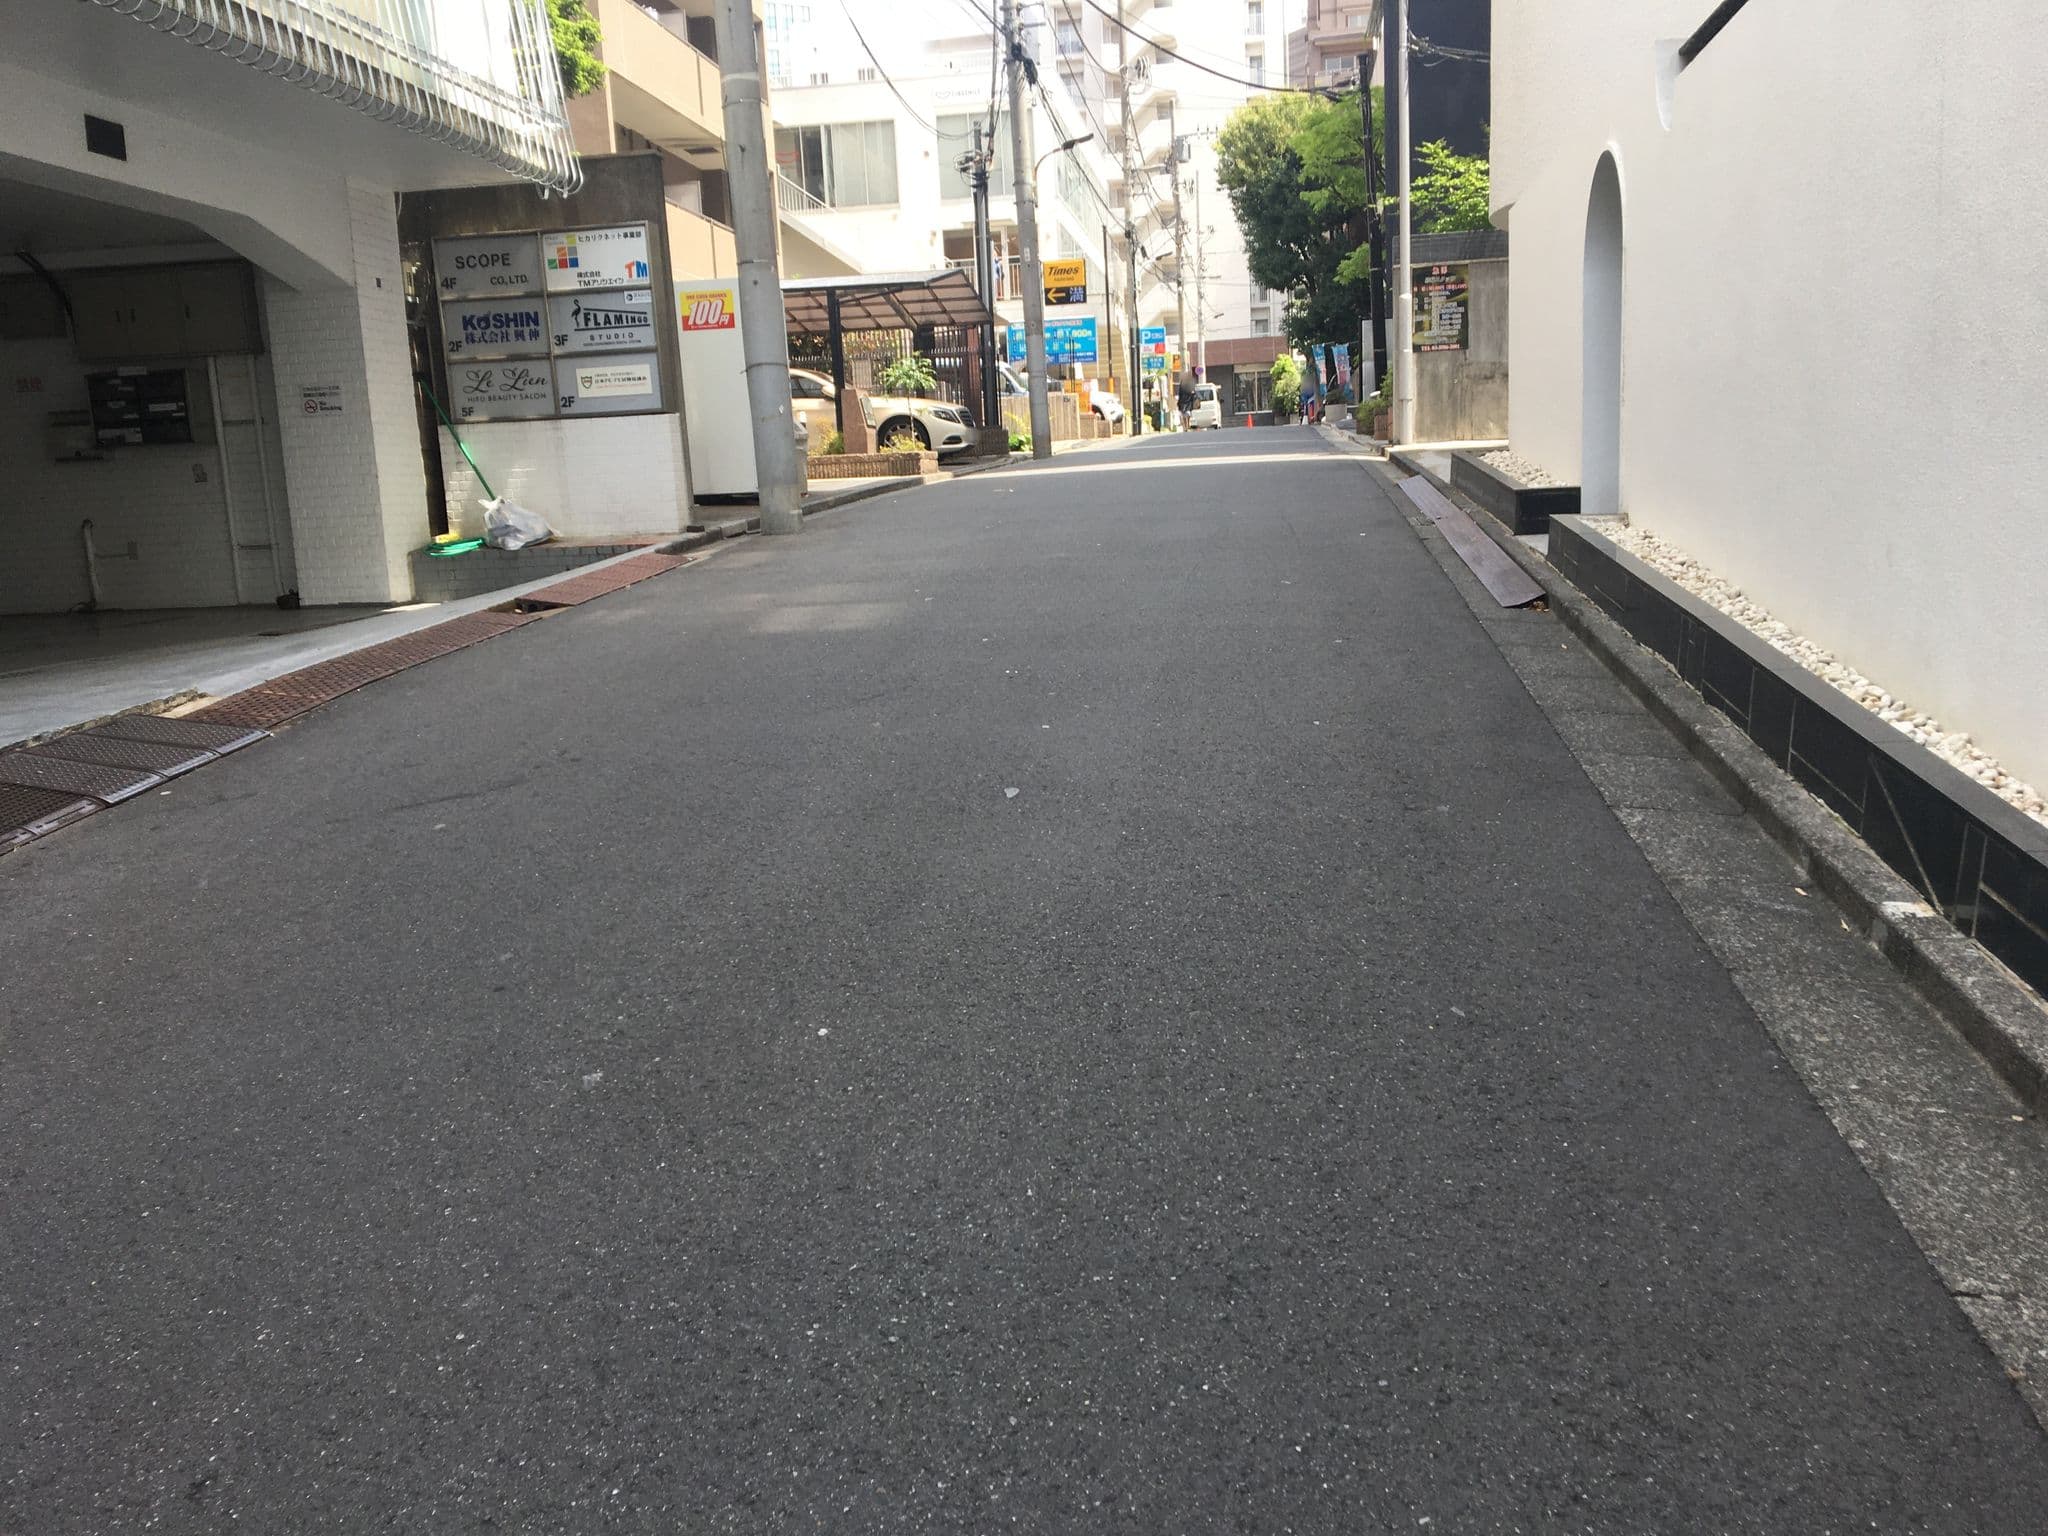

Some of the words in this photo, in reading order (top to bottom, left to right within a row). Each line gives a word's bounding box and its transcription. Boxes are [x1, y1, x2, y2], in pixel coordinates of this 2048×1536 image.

[455, 253, 512, 269] SCOPE
[625, 260, 648, 279] TM
[1048, 266, 1080, 276] Times
[441, 277, 457, 289] 4F
[583, 312, 648, 327] FLAMINGO
[554, 334, 568, 346] 3F
[590, 332, 634, 341] STUDIO
[1141, 331, 1151, 344] P
[448, 341, 462, 352] 2F
[519, 392, 547, 400] SALON
[561, 396, 575, 408] 2F
[461, 406, 474, 417] 5F
